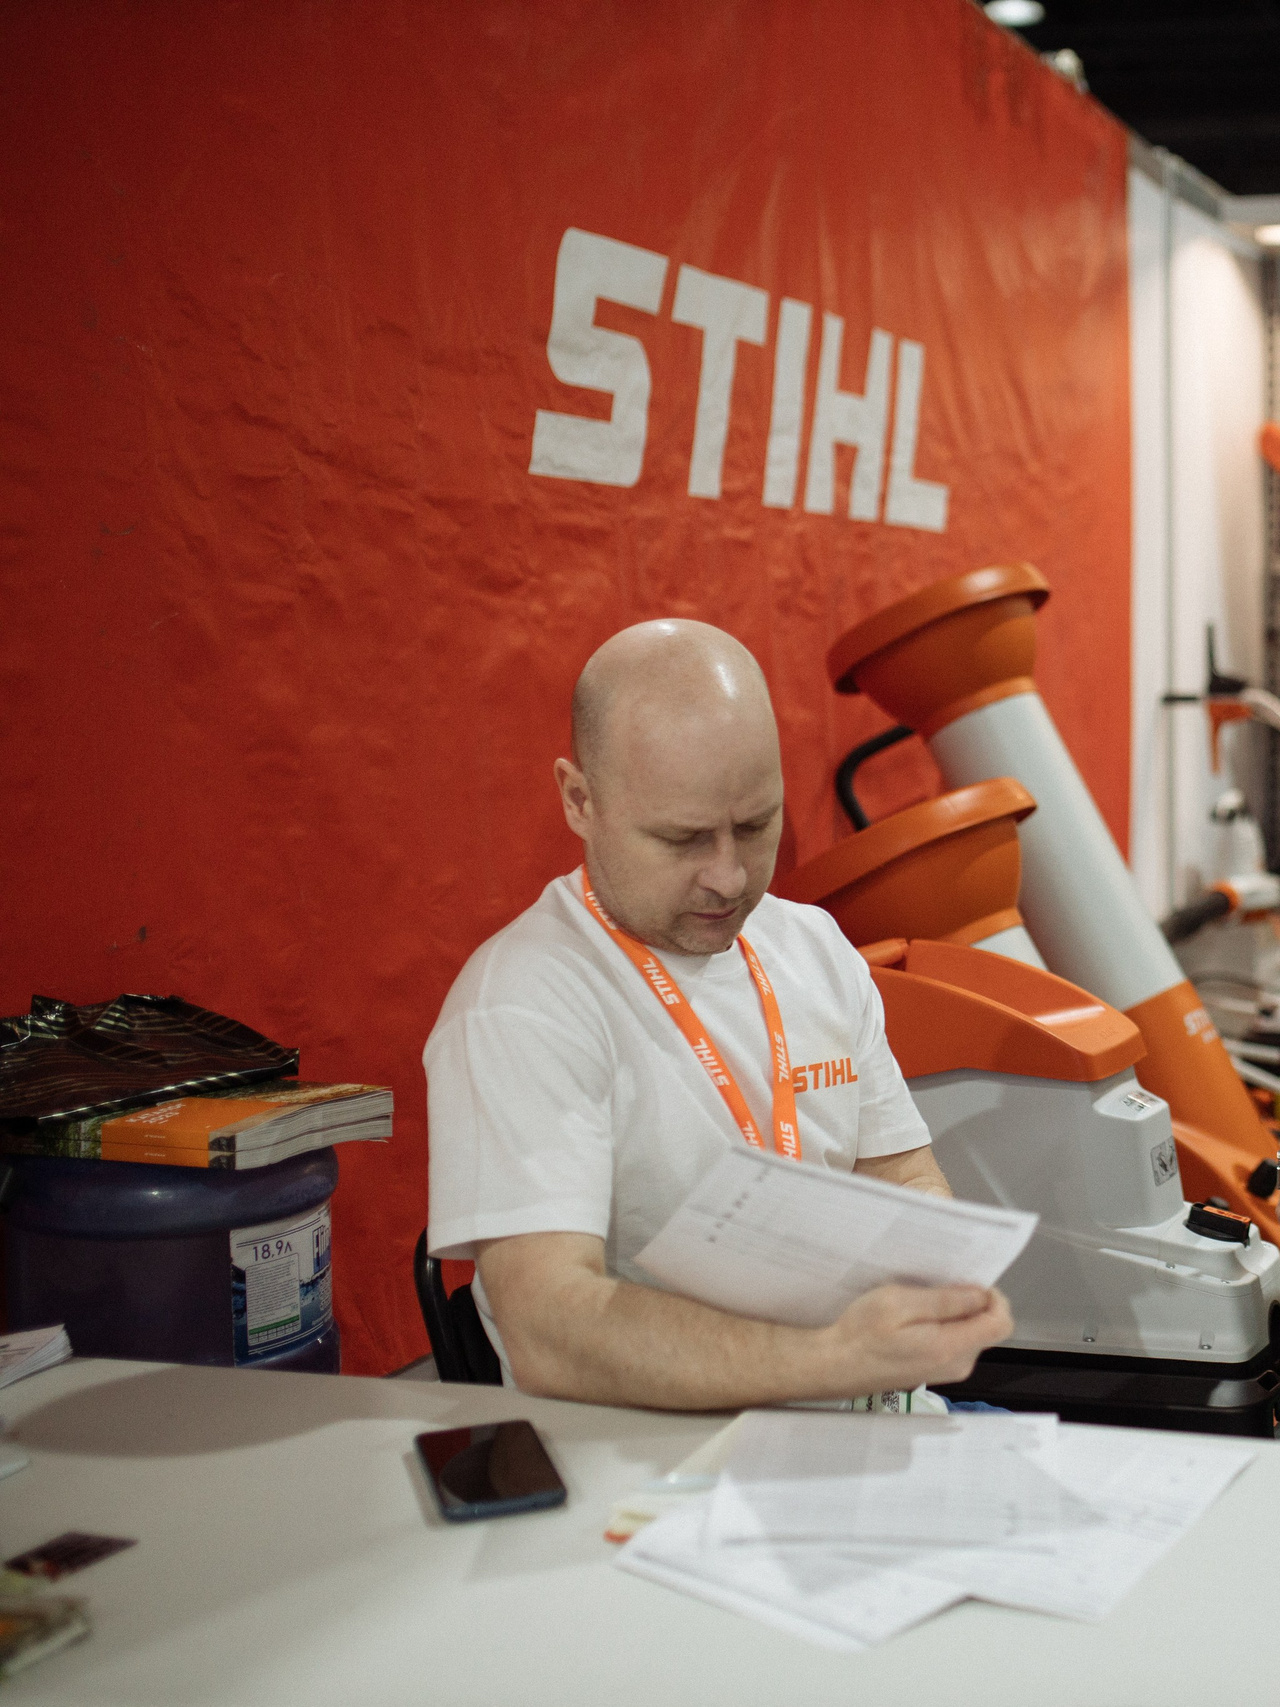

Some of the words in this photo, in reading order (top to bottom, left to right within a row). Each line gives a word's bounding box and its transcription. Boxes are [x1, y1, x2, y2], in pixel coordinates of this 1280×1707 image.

[528, 226, 950, 533] STIHL
[643, 957, 680, 1005] STIHL
[749, 952, 771, 996] STIHL
[692, 1037, 730, 1088] STIHL
[774, 1031, 790, 1083] STIHL
[791, 1057, 858, 1094] STIHL
[779, 1121, 799, 1162] STIH
